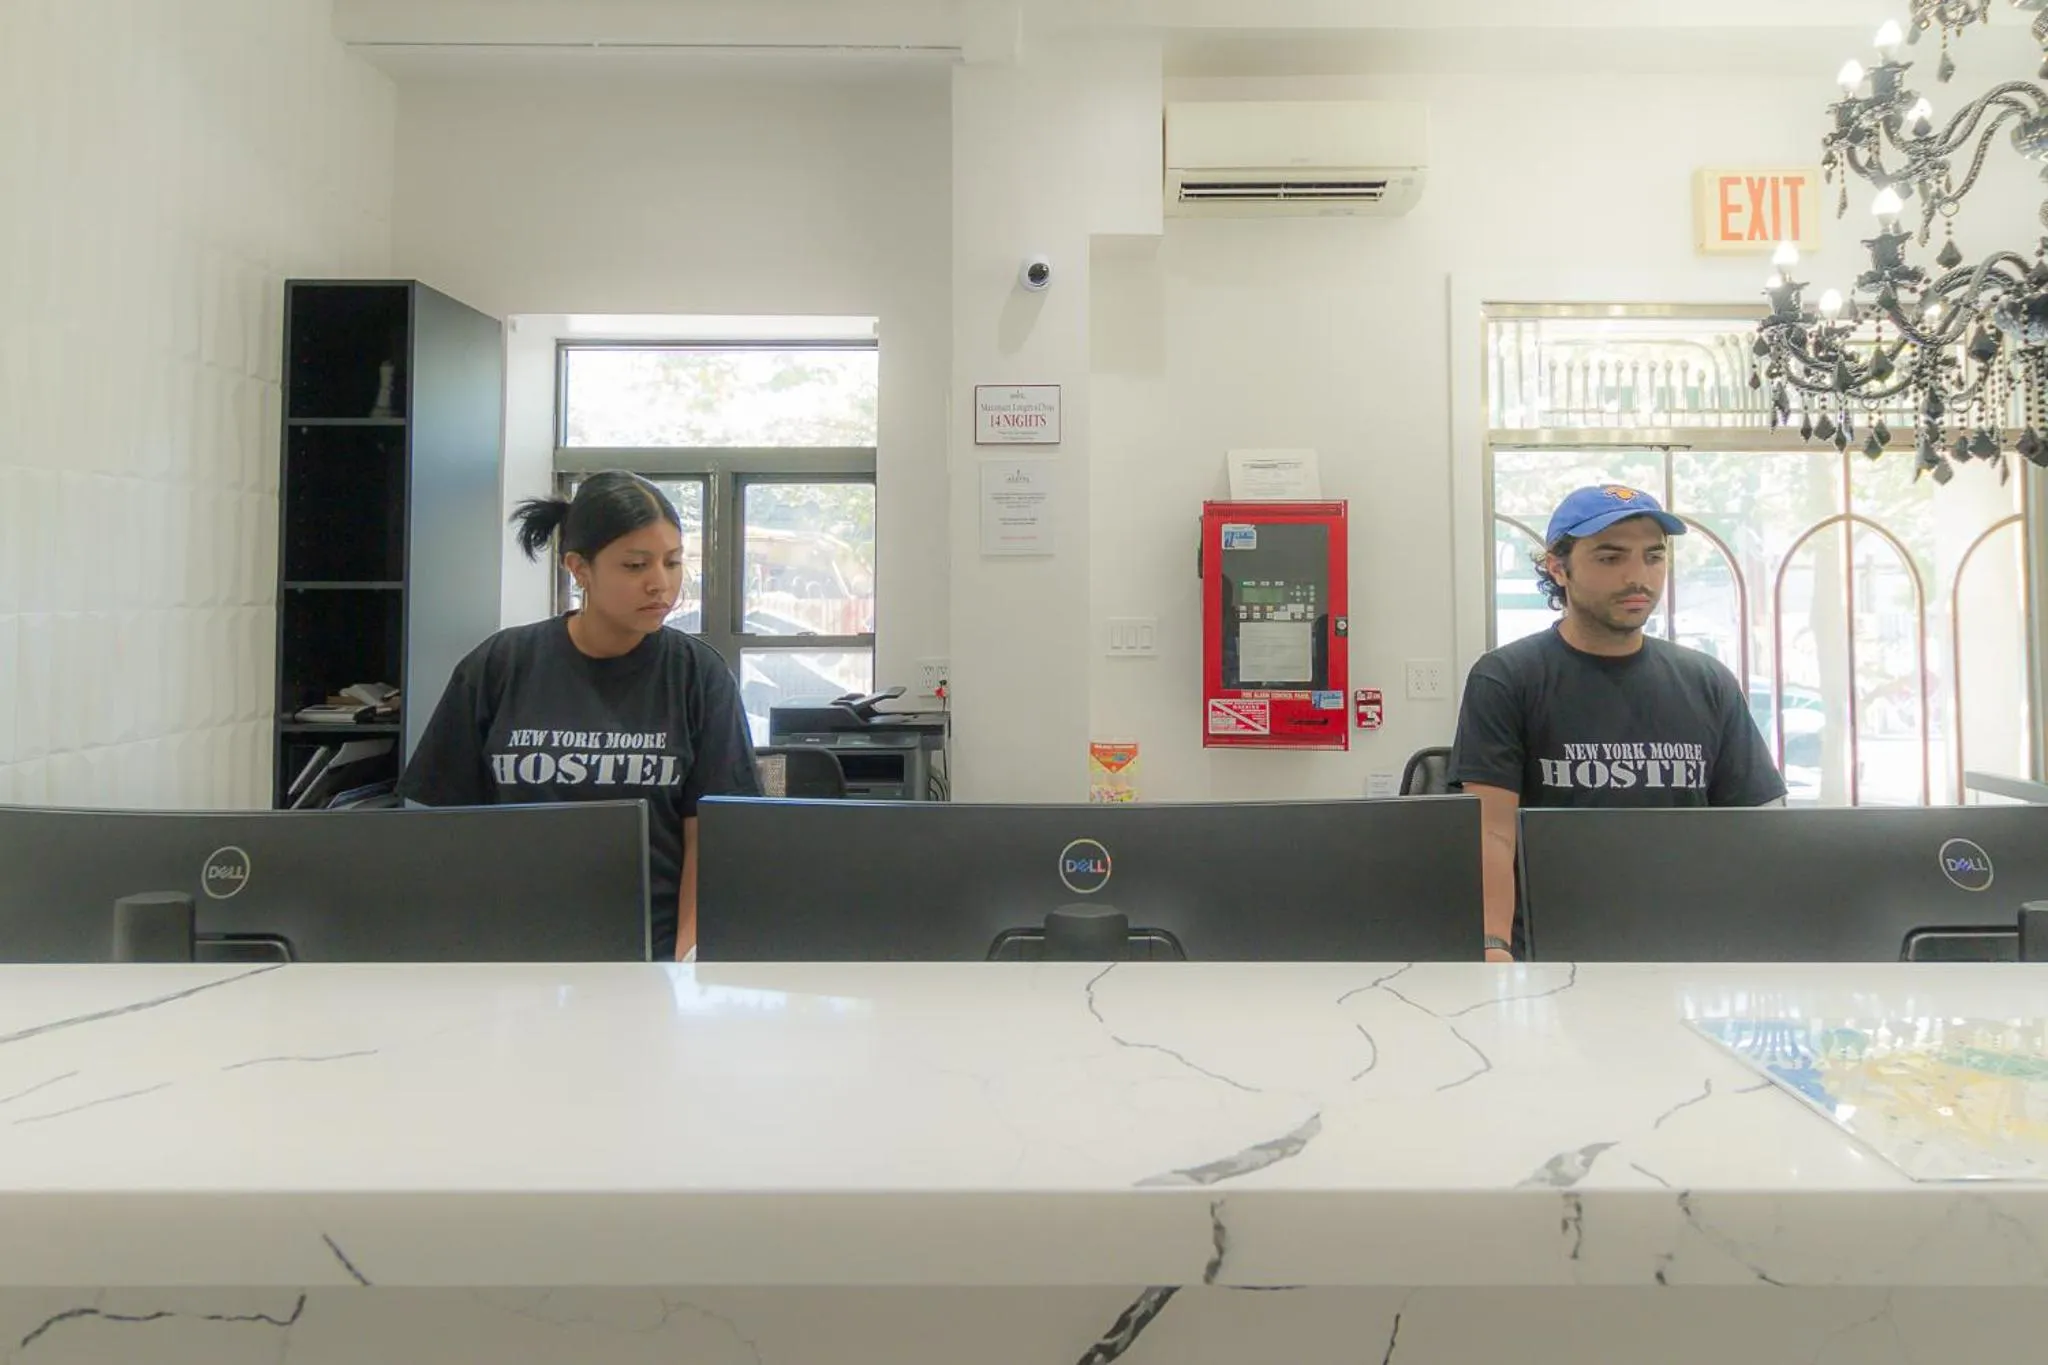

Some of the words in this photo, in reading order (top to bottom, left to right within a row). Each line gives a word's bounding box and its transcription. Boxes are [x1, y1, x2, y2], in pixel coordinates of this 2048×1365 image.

[1719, 176, 1805, 241] EXIT
[1003, 414, 1047, 428] NIGHTS
[508, 729, 549, 747] NEW
[550, 730, 602, 748] YORK
[604, 732, 667, 749] MOORE
[1563, 743, 1599, 760] NEW
[1602, 743, 1646, 760] YORK
[1649, 742, 1702, 760] MOORE
[492, 752, 680, 785] HOSTEL
[208, 865, 244, 879] DELL
[1066, 859, 1106, 873] DELL
[1945, 858, 1988, 871] DELL
